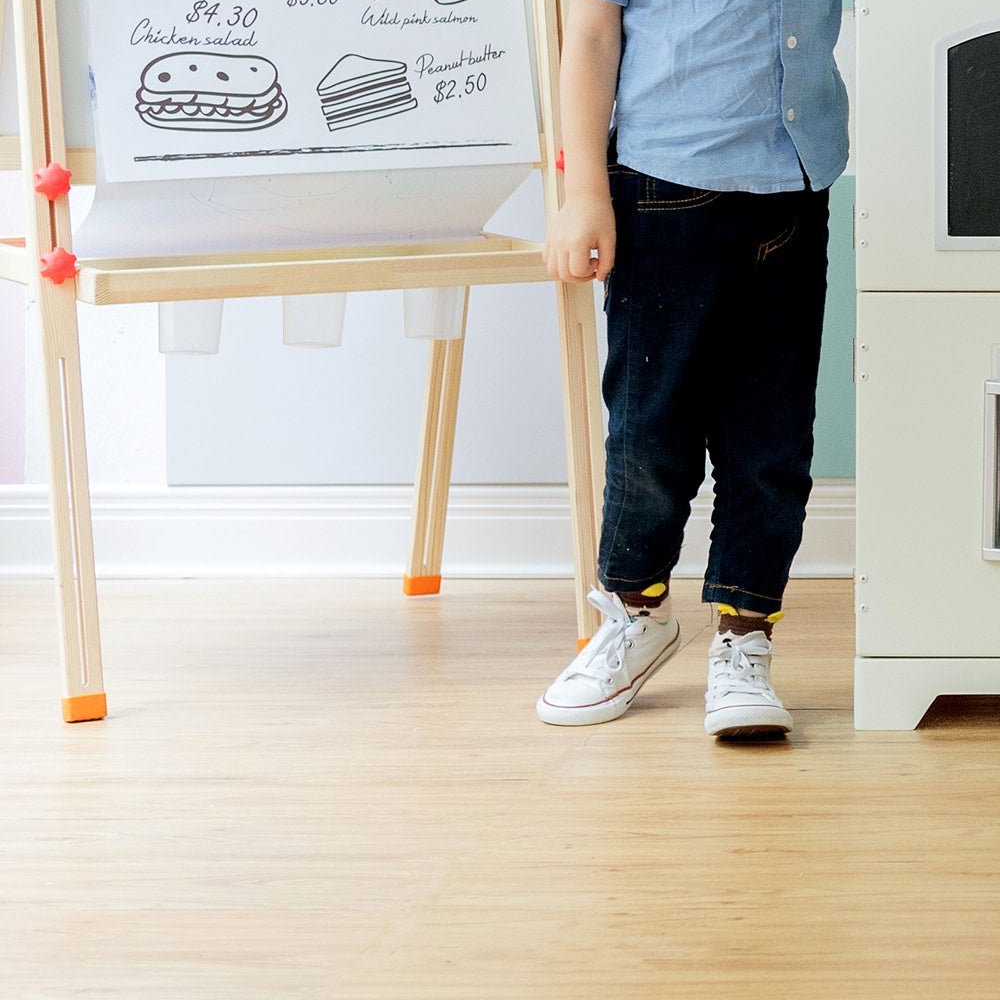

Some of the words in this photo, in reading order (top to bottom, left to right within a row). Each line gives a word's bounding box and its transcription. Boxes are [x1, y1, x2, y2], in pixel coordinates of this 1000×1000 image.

[185, 0, 258, 28] $4.30
[360, 6, 400, 26] Wild
[400, 10, 432, 31] pink
[433, 11, 478, 25] salmon
[130, 18, 201, 46] Chicken
[202, 30, 258, 47] salad
[433, 72, 487, 104] $2.50
